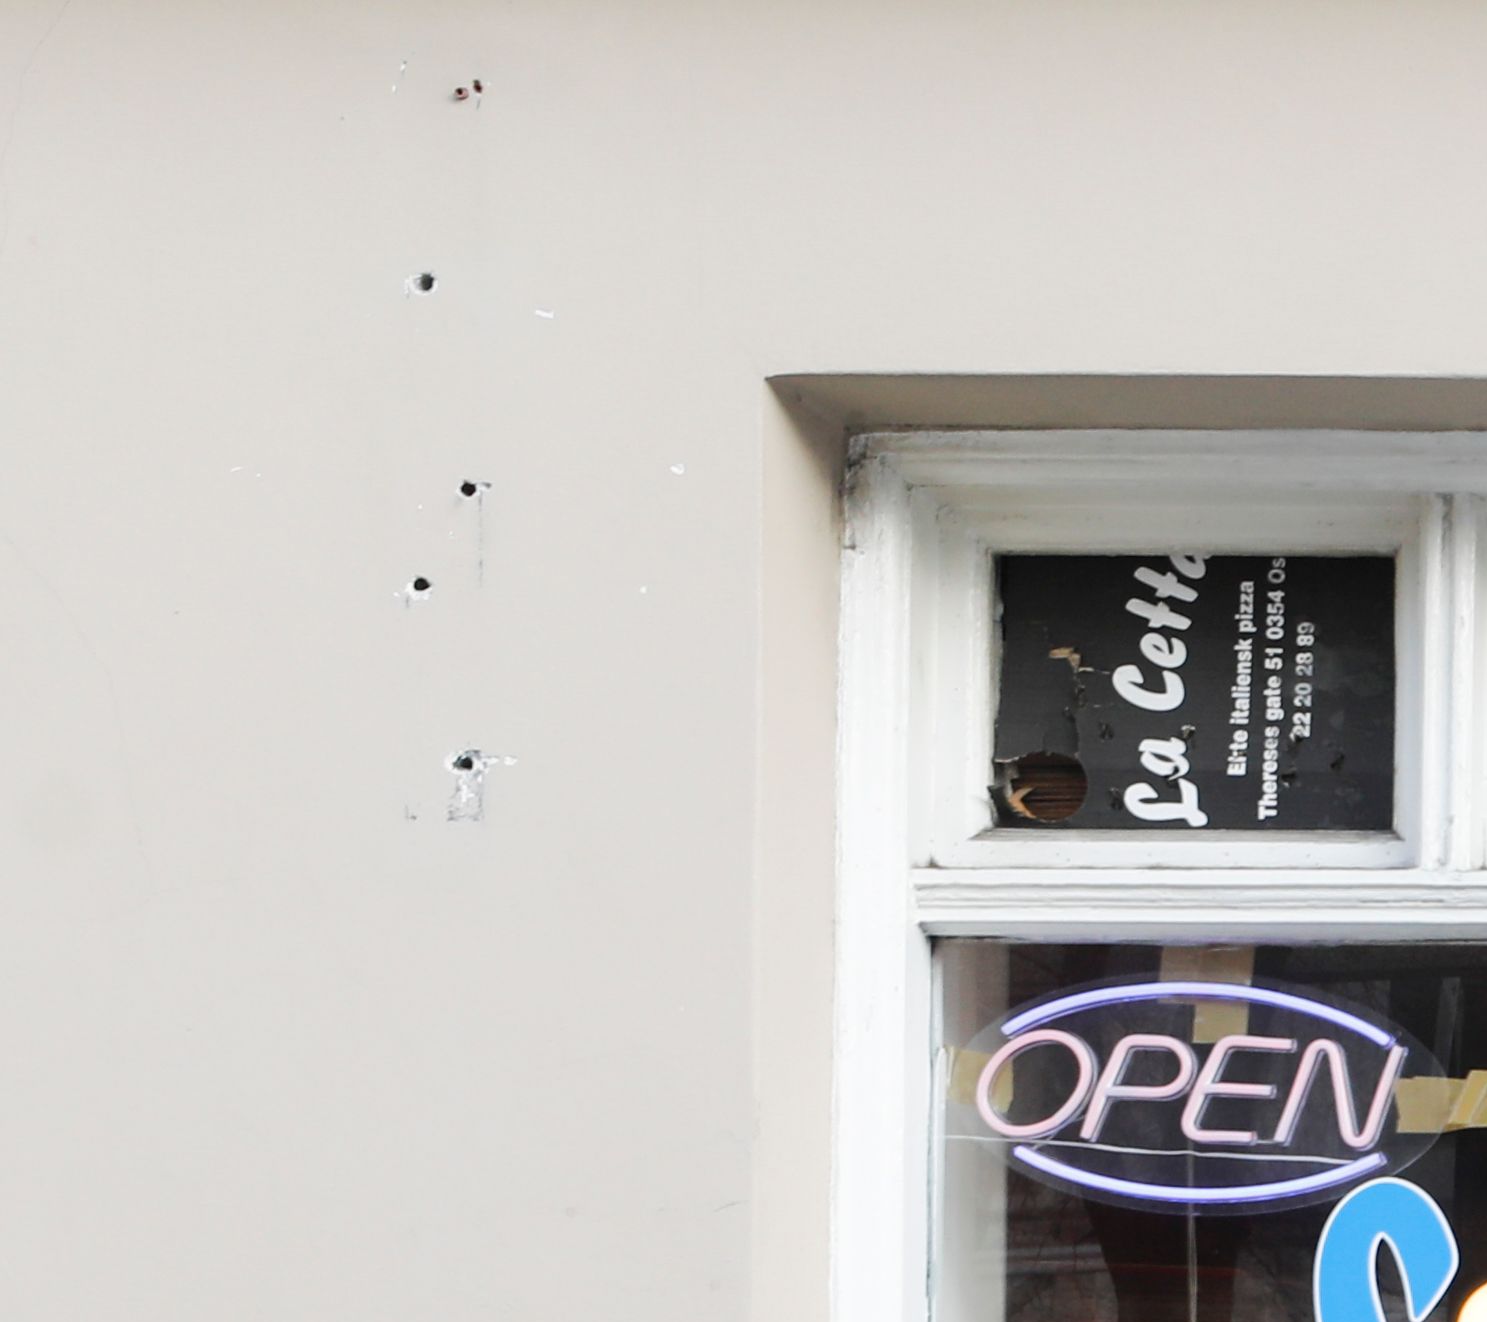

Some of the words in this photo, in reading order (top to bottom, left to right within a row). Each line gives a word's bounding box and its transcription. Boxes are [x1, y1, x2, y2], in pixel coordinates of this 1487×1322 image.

[1234, 580, 1257, 632] pizza
[1266, 590, 1285, 640] 0354
[1296, 621, 1315, 646] 89
[1229, 638, 1253, 725] italiensk
[1265, 646, 1283, 670] 51
[1295, 651, 1314, 676] 28
[1263, 675, 1284, 721] gate
[1294, 682, 1313, 707] 20
[1293, 712, 1312, 737] 22
[1124, 737, 1208, 827] La
[1258, 726, 1280, 820] Thereses
[976, 1028, 1408, 1150] OPEN
